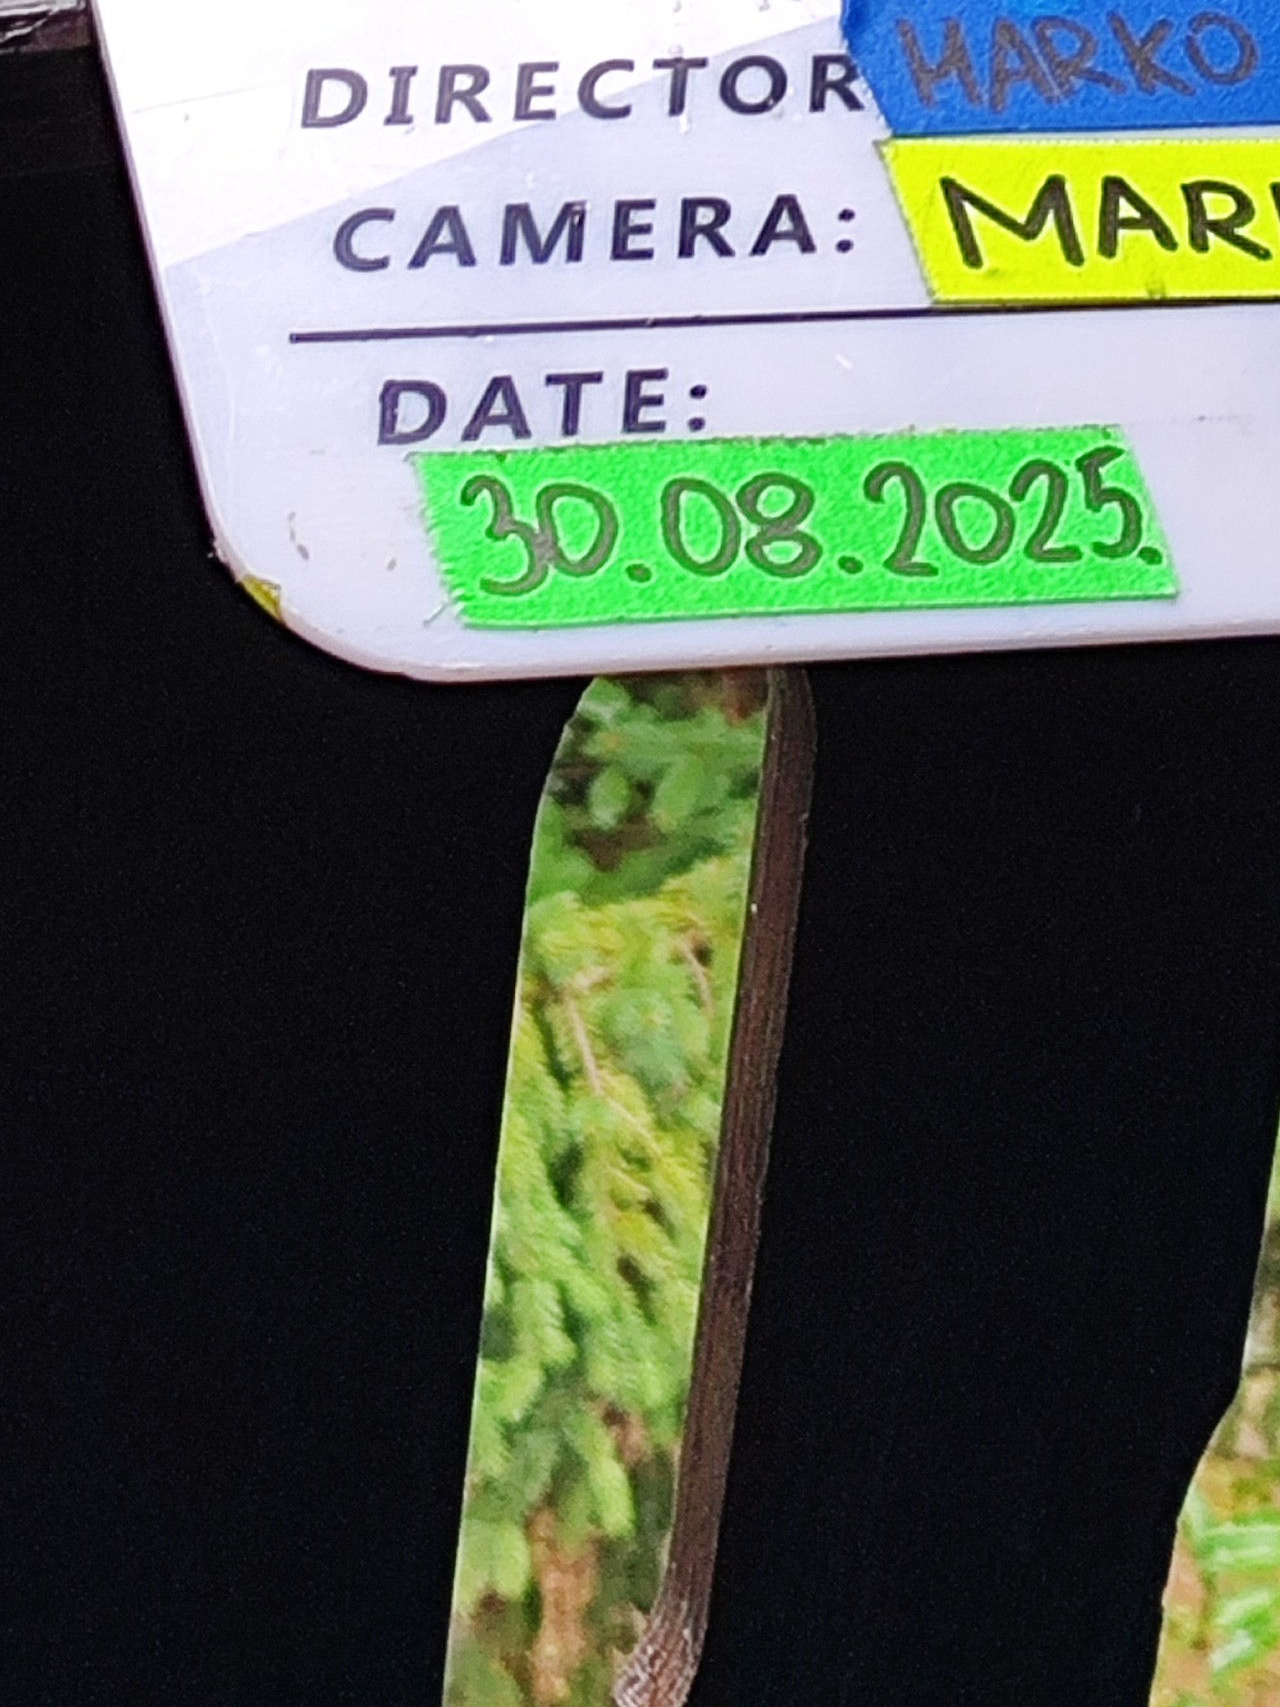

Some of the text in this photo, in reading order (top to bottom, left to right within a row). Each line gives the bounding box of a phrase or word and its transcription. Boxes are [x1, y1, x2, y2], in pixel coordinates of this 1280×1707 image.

[300, 53, 864, 129] DIRECTOR
[895, 10, 1259, 114] MARKO
[332, 194, 857, 271] CAMERA:
[377, 368, 709, 446] DATE:
